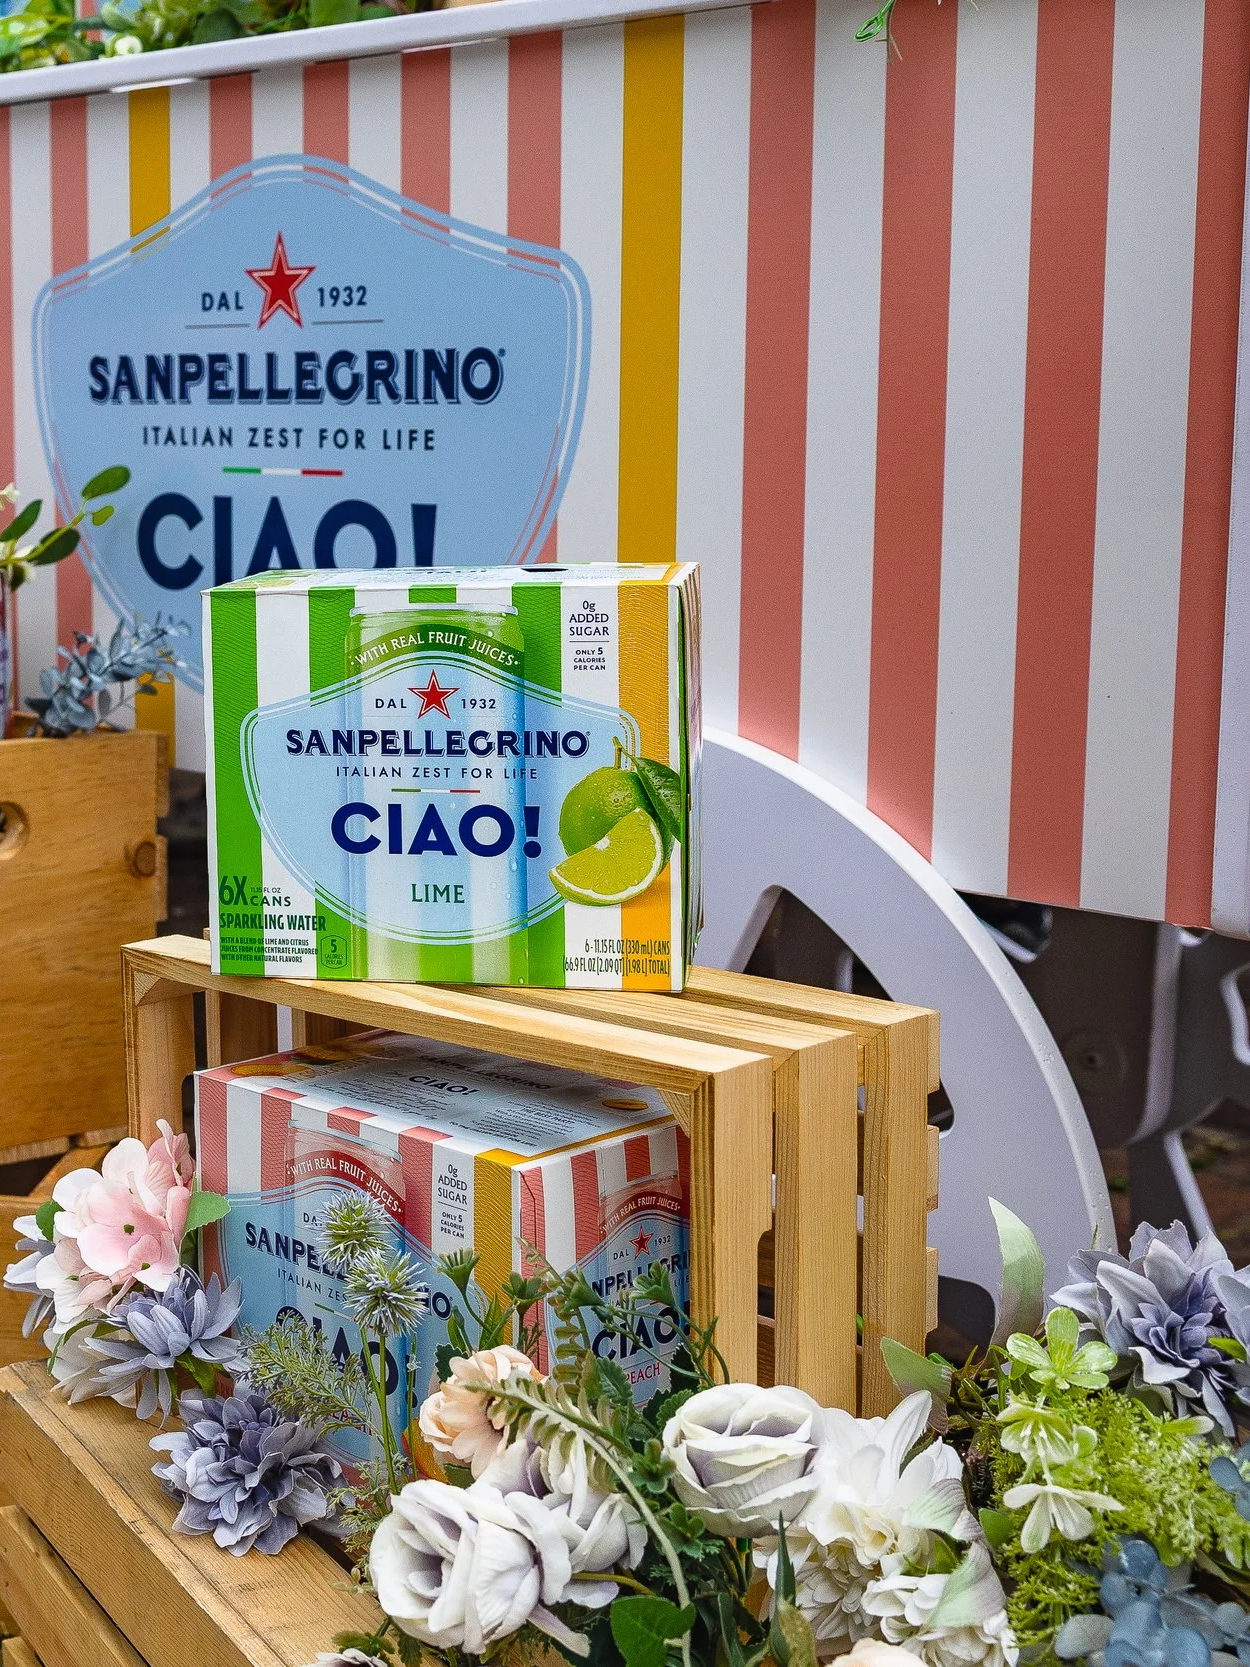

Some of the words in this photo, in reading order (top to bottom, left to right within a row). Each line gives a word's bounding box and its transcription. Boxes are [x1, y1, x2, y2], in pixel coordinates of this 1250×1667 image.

[201, 292, 244, 312] DAL
[318, 286, 368, 308] 1932
[88, 346, 506, 406] SANPELLEGRINO
[143, 426, 233, 448] ITALIAN
[248, 428, 303, 449] ZEST
[319, 429, 366, 450] FOR
[382, 430, 436, 452] LIFE
[582, 600, 596, 612] 0g
[569, 613, 609, 623] ADDED
[569, 626, 609, 636] SUGAR
[354, 642, 389, 666] WITH
[390, 632, 425, 651] REAL
[428, 631, 468, 647] FRUIT
[468, 640, 515, 667] JUICES
[597, 647, 603, 655] 5
[375, 698, 407, 709] DAL
[461, 698, 496, 709] 1932
[286, 729, 589, 758] SANPELLEGRINO
[335, 766, 402, 778] ITALIAN
[412, 767, 450, 779] ZEST
[461, 767, 494, 779] FOR
[504, 768, 538, 780] LIFE
[331, 802, 542, 859] CIAO!
[219, 875, 248, 906] 6X
[411, 883, 465, 904] LIME
[250, 896, 292, 907] CANS
[220, 913, 284, 930] SPARKLING
[287, 915, 327, 932] WATER
[330, 939, 337, 953] 5
[654, 940, 670, 955] CANS
[408, 1074, 480, 1096] CIAO!
[447, 1164, 458, 1178] 0g
[290, 1160, 313, 1176] WITH
[314, 1157, 338, 1170] REAL
[339, 1159, 367, 1182] FRUIT
[366, 1176, 400, 1212] JUICES
[438, 1174, 468, 1192] ADDED
[438, 1188, 468, 1207] SUGAR
[442, 1211, 457, 1222] ONLY
[458, 1213, 463, 1223] 5
[603, 1214, 620, 1233] WITH
[619, 1202, 638, 1217] REAL
[637, 1196, 657, 1207] FRUIT
[656, 1198, 679, 1210] JUICES
[440, 1219, 465, 1232] CALORIES
[440, 1227, 452, 1238] PER
[452, 1229, 465, 1240] CAN
[613, 1250, 630, 1261] DAL
[654, 1235, 672, 1246] 1932
[277, 1267, 321, 1294] ITALIAN
[328, 1286, 348, 1303] ZES
